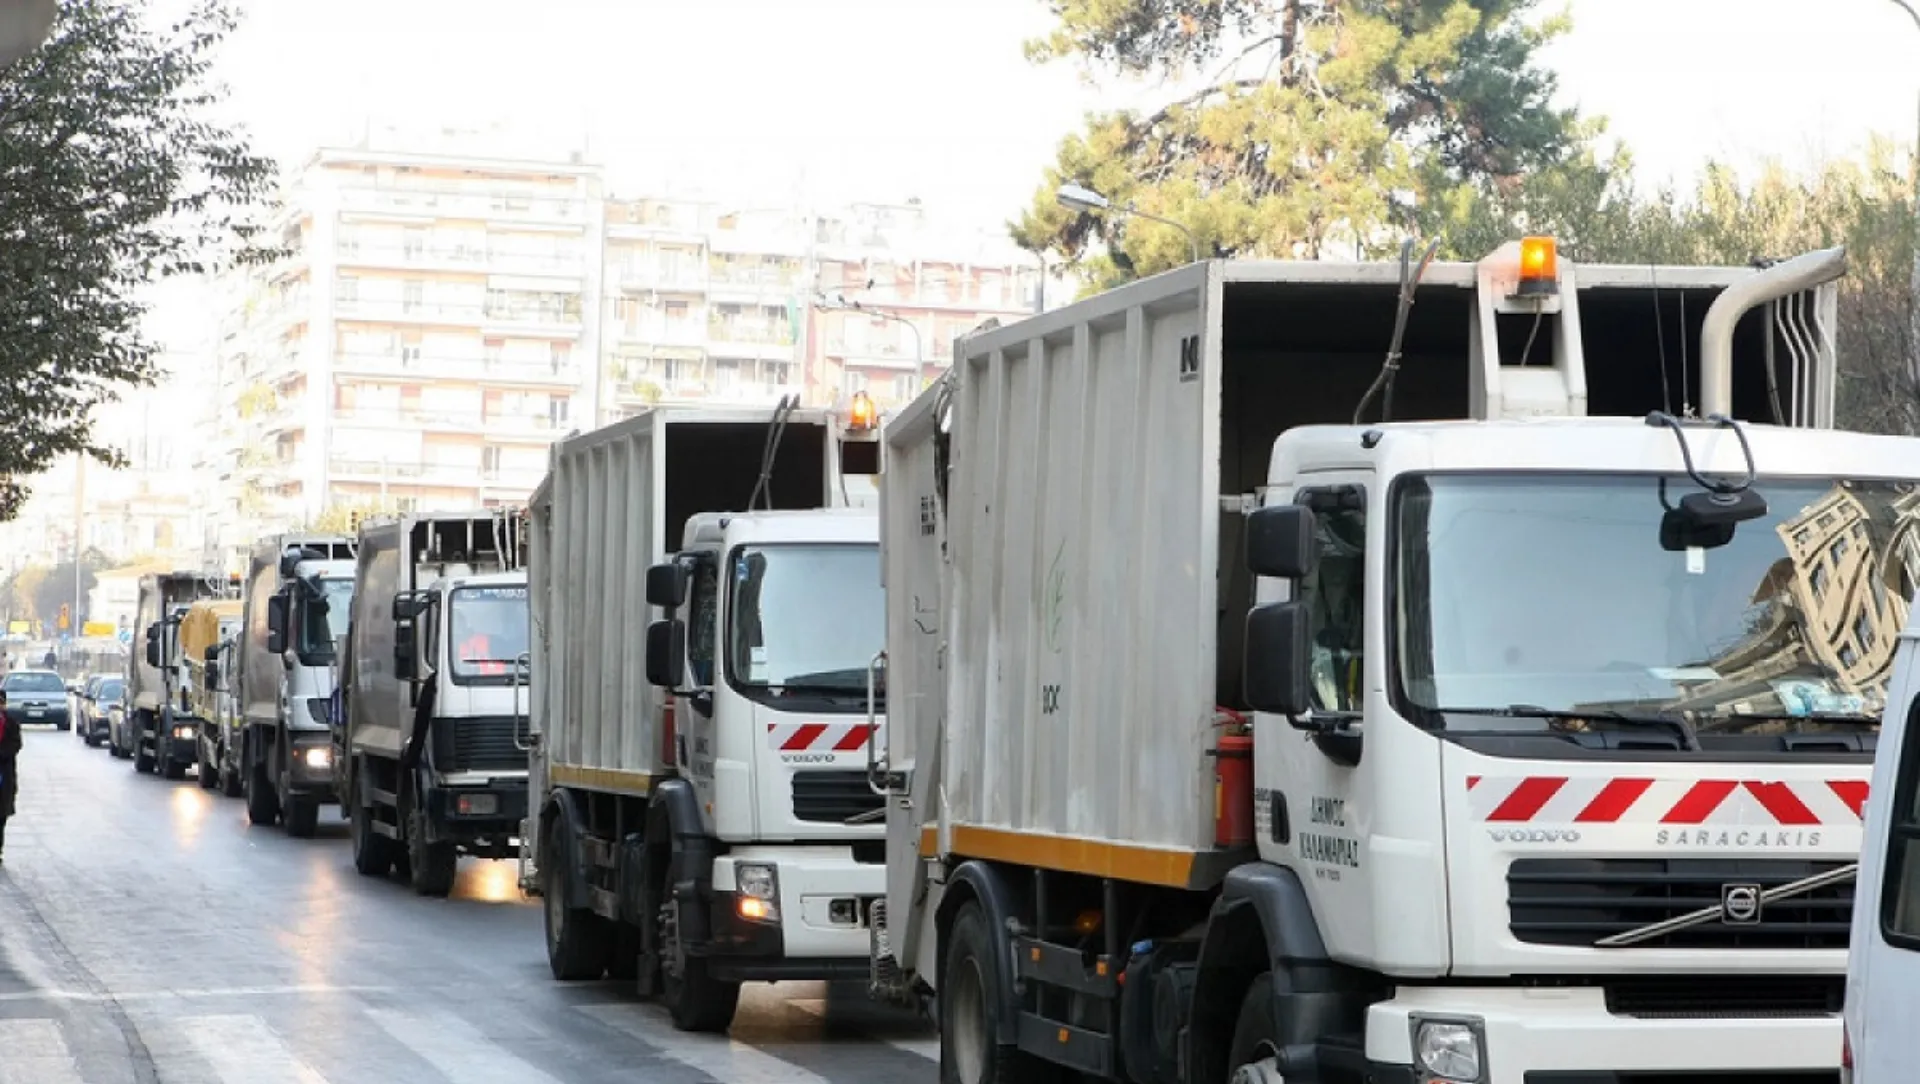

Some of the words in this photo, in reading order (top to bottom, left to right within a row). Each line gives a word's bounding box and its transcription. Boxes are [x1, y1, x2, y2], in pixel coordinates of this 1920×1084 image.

[780, 754, 835, 763] VOLVO
[1486, 828, 1582, 842] VOLVO
[1656, 830, 1822, 846] SARACAKIS
